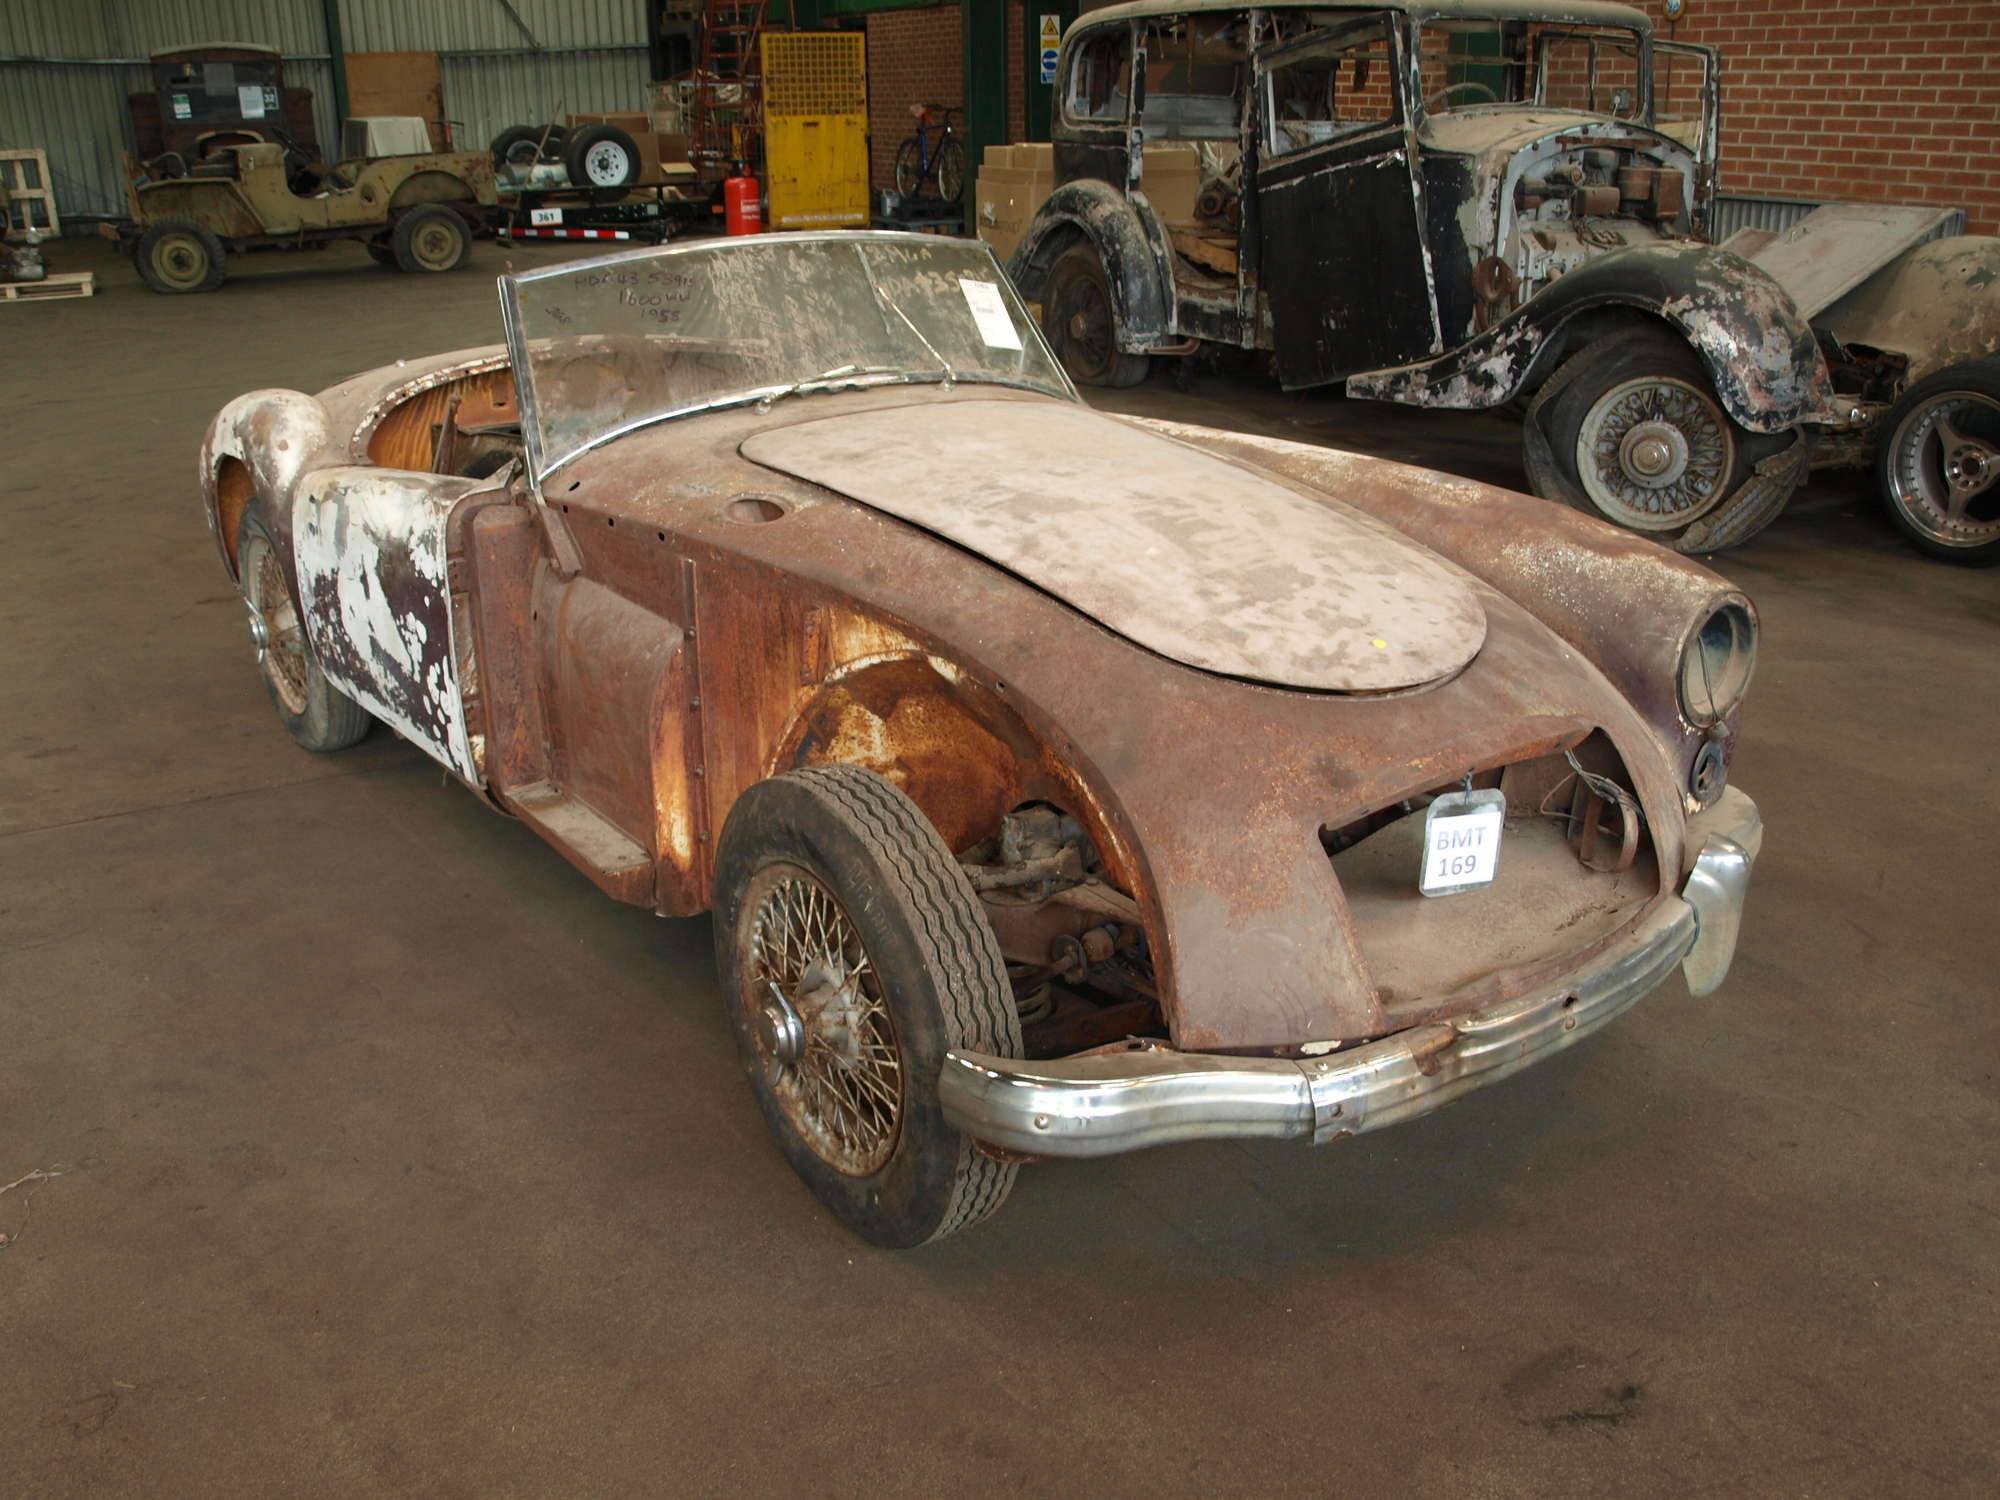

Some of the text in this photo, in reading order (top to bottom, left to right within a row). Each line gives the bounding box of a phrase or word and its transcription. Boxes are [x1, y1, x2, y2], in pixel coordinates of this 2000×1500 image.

[538, 213, 555, 222] 361
[619, 289, 662, 306] 1600
[1436, 826, 1488, 851] BMT
[1437, 854, 1477, 878] 169
